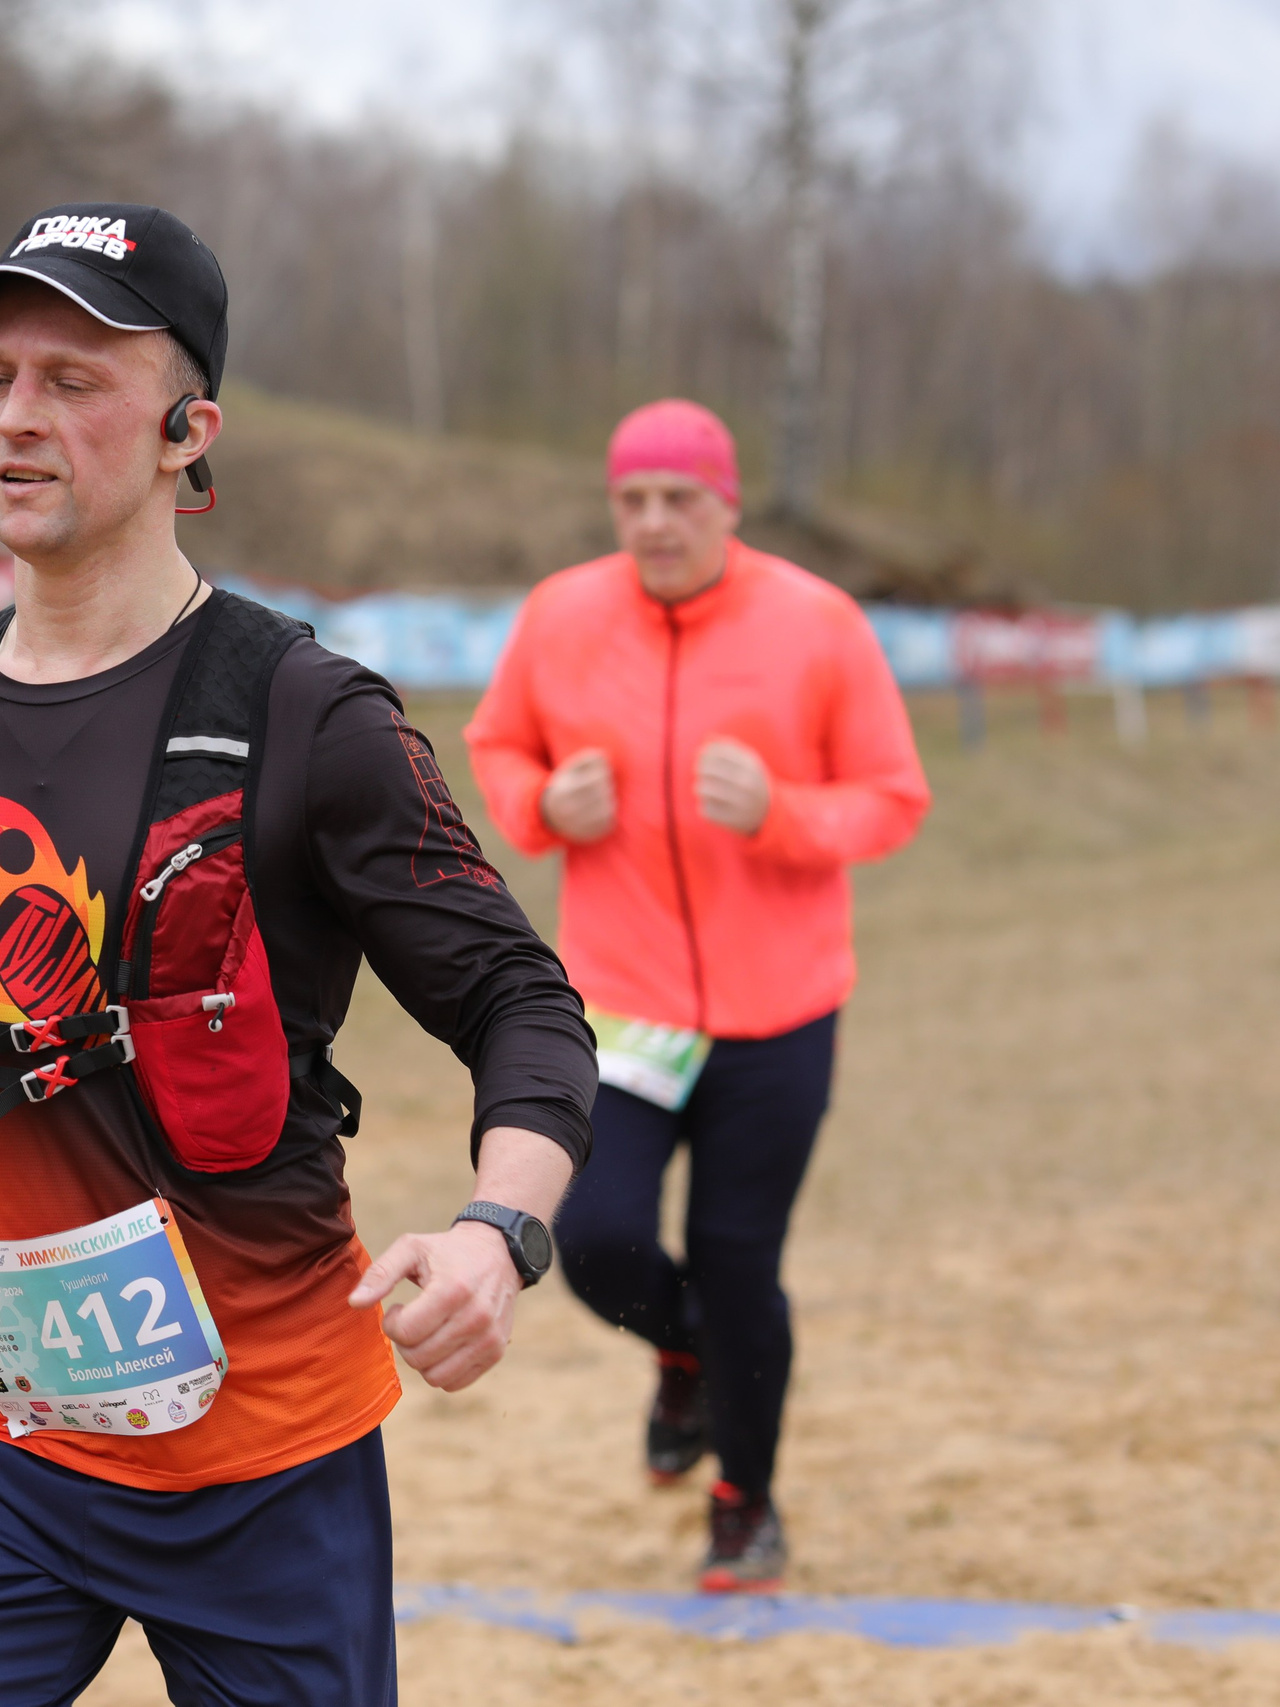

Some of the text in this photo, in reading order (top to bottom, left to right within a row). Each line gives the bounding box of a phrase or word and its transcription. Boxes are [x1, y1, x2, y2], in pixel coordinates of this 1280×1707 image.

[28, 214, 126, 240] ГОНКА
[10, 231, 127, 261] ГЕРОЕВ
[16, 1214, 157, 1267] ХИМКИНСКИЙ ЛЕС
[60, 1271, 109, 1292] ТушиНоги
[40, 1276, 183, 1360] 412
[67, 1347, 175, 1383] Болош Алексей
